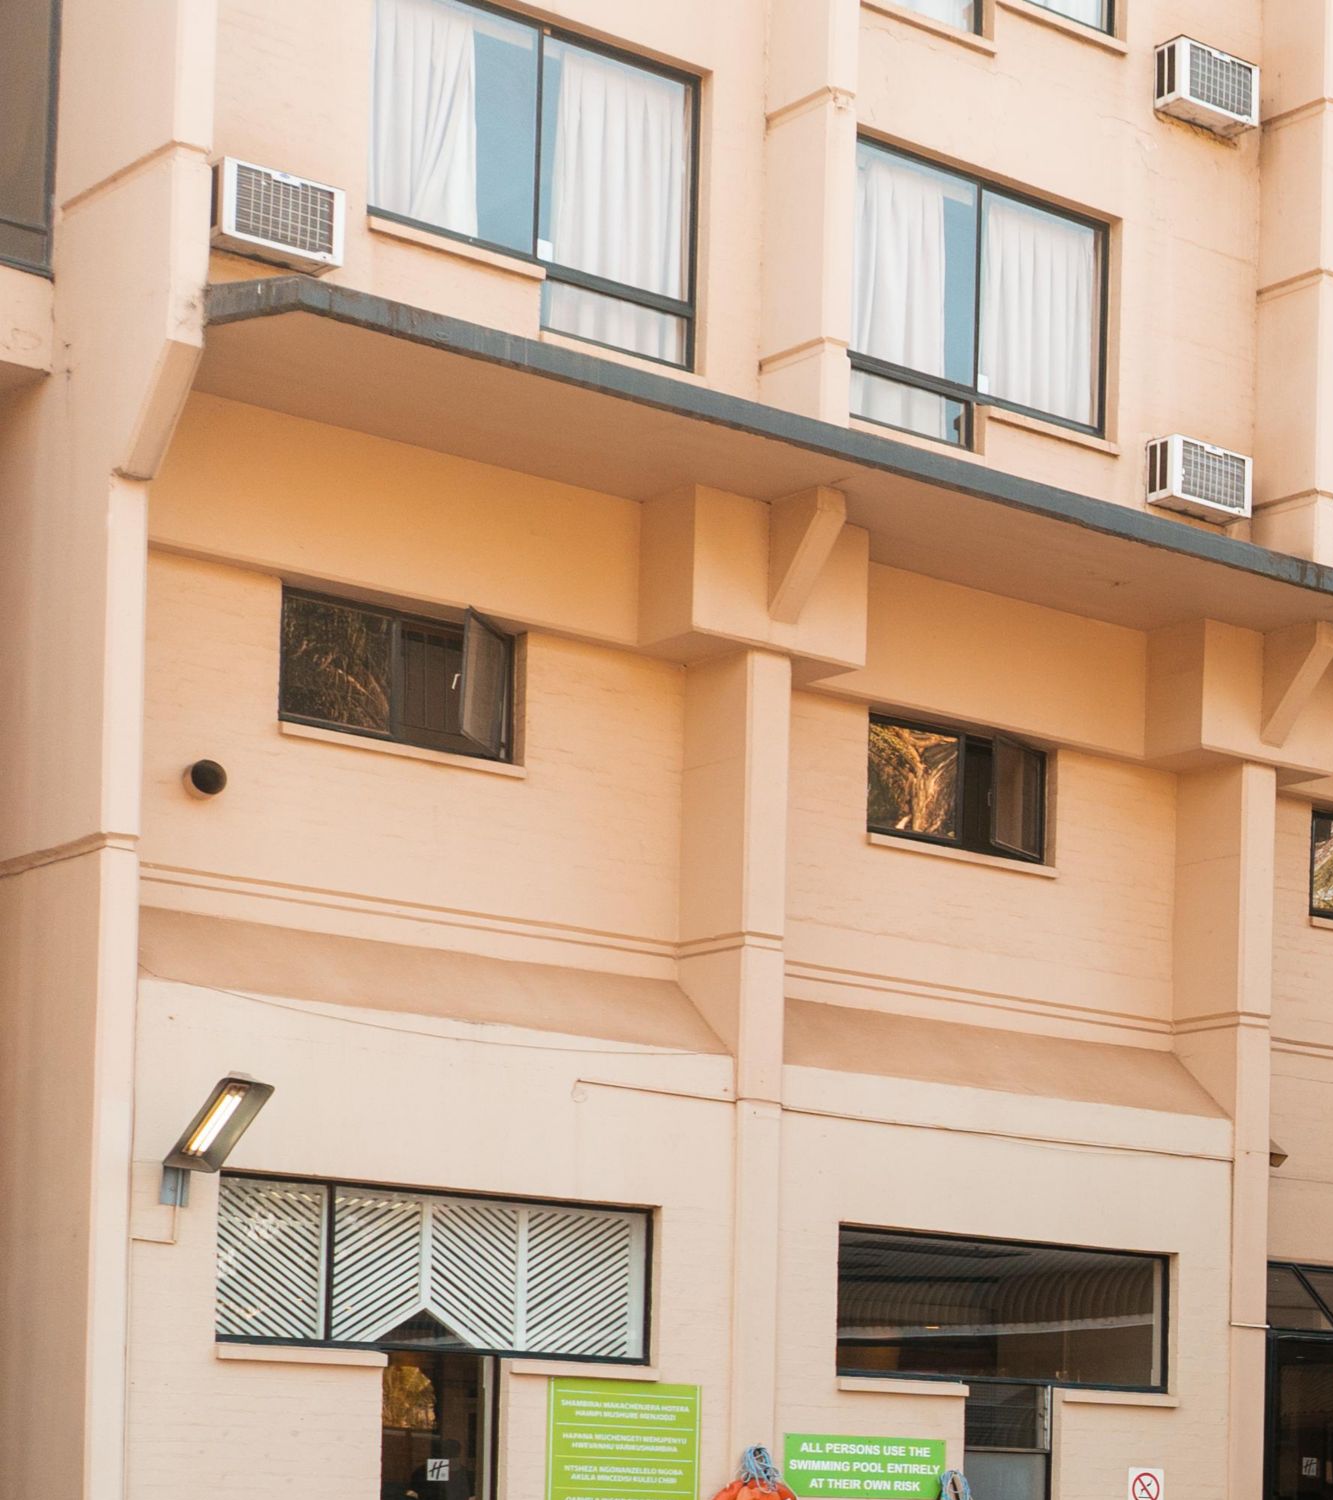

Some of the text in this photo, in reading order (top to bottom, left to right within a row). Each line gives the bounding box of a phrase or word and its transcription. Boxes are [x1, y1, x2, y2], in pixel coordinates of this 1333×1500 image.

[800, 1442, 931, 1457] ALL PERSONS USE THE
[789, 1459, 940, 1475] SWIMMING POOL ENTIRELY
[809, 1478, 920, 1491] AT THEIR OWN RISK
